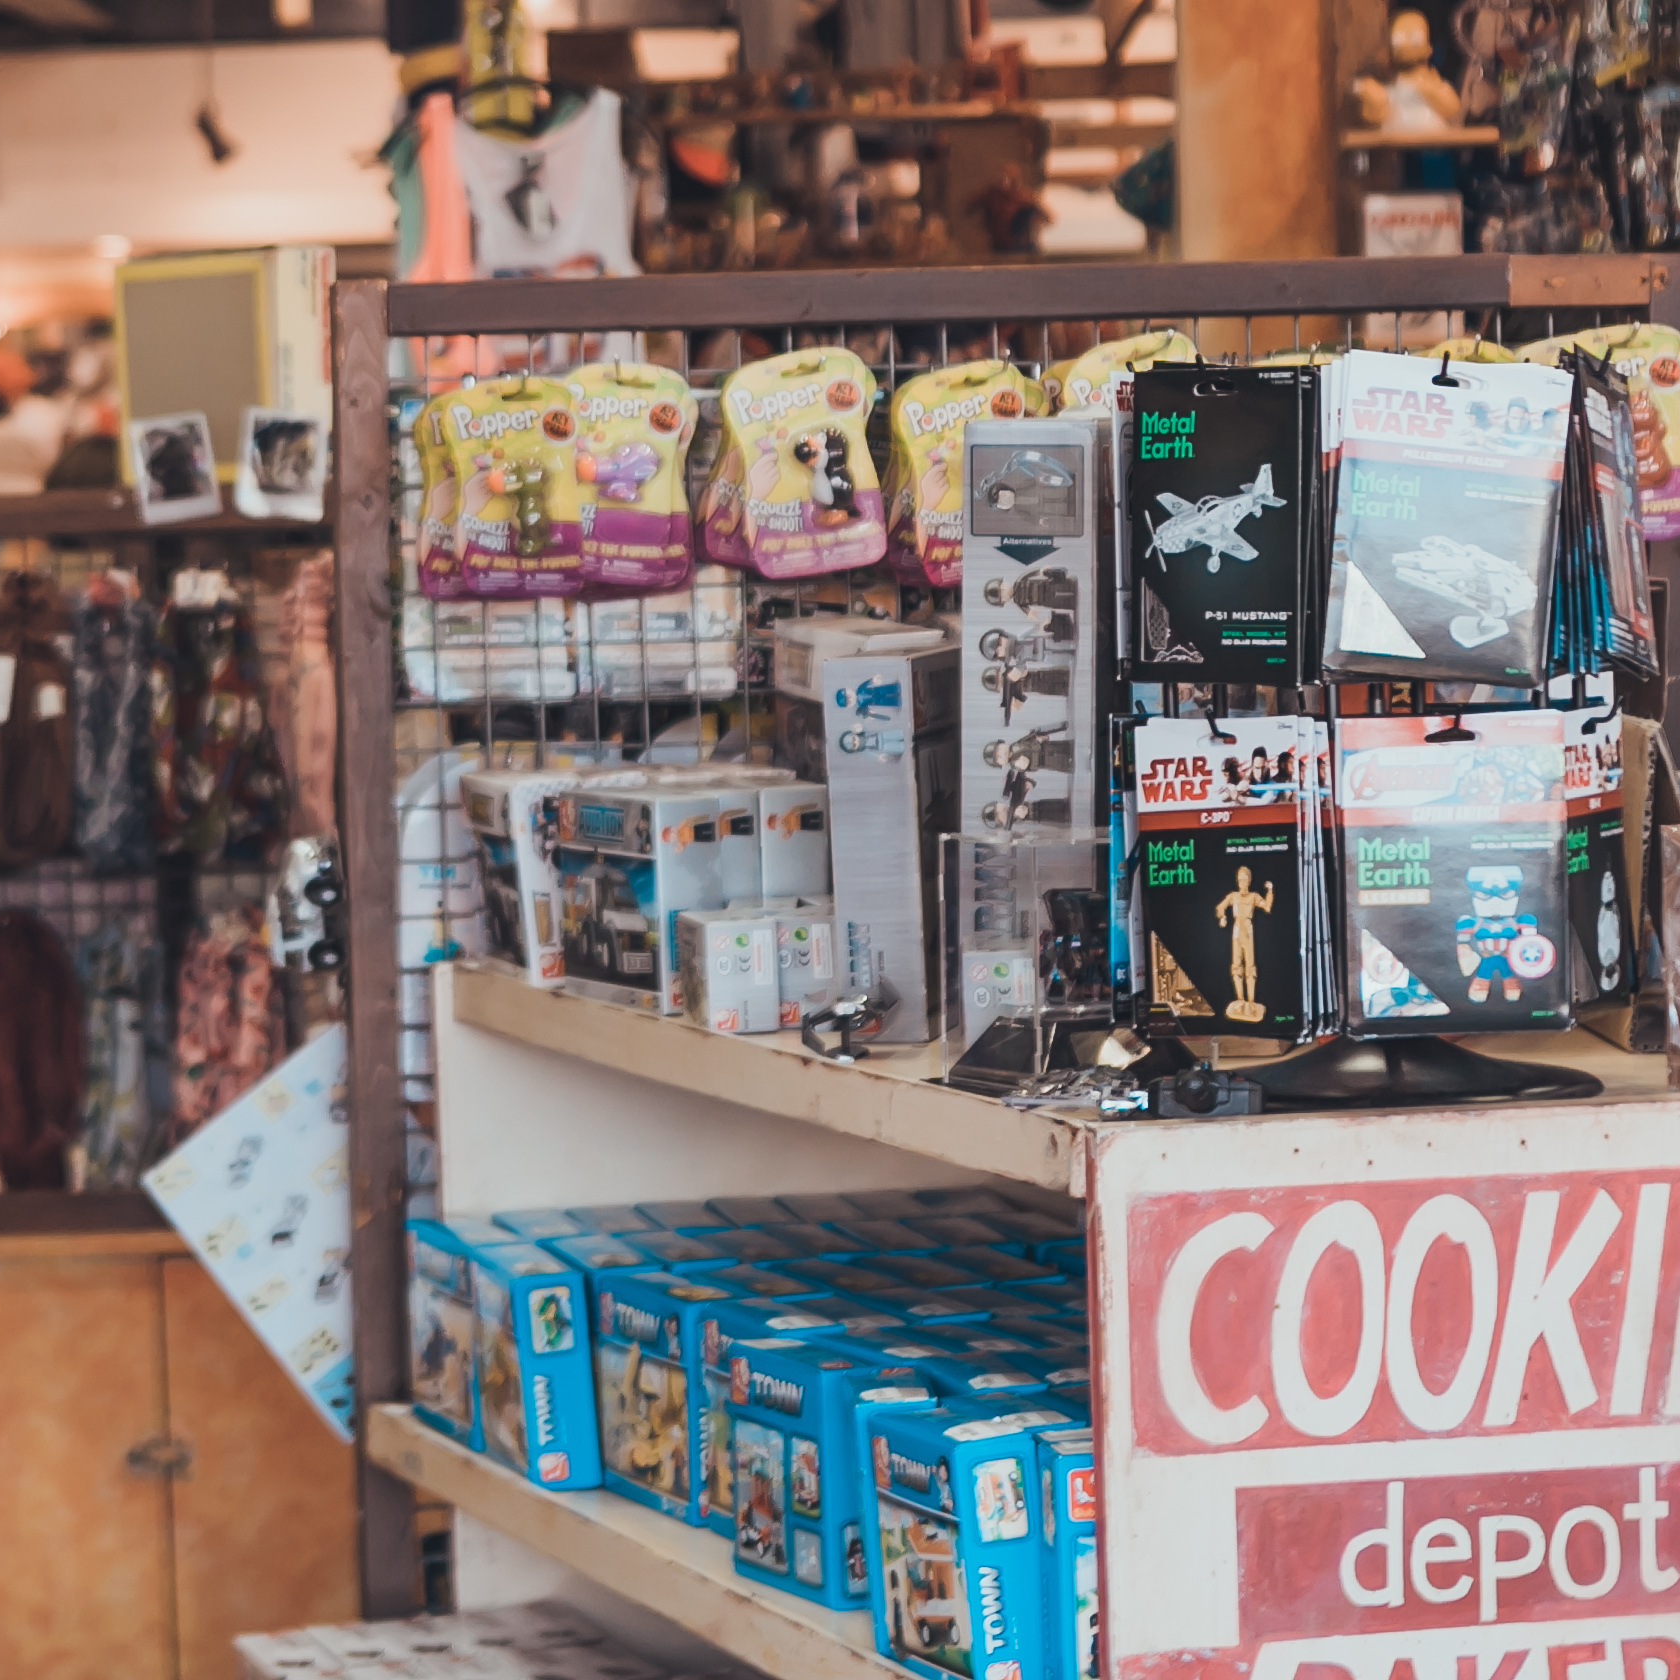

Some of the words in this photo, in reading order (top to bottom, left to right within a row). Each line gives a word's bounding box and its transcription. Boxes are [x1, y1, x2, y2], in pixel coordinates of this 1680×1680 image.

[731, 382, 822, 426] Popper
[1351, 386, 1454, 417] STAR
[451, 403, 540, 441] Popper
[903, 394, 988, 438] Popper
[1140, 410, 1197, 436] Metal
[1351, 407, 1453, 440] WARS
[1140, 436, 1195, 460] Earth
[1352, 469, 1422, 499] Metal
[748, 497, 804, 518] SQUEEZE
[919, 509, 963, 526] SQUEEZ
[1350, 491, 1419, 522] Earth
[936, 525, 963, 539] SHOO
[1001, 536, 1055, 547] Alternatives
[1204, 610, 1229, 621] P-51
[1140, 755, 1213, 781] STAR
[1141, 778, 1213, 804] WARS
[578, 806, 625, 841] AVIATION
[1199, 811, 1230, 824] C-3PO
[1147, 838, 1195, 863] Metal
[1356, 835, 1432, 862] Metal
[1147, 862, 1195, 887] Earth
[1356, 861, 1432, 888] Earth
[752, 1371, 805, 1416] TOWN
[1338, 1466, 1680, 1625] depot
[977, 1565, 1008, 1657] TOWN
